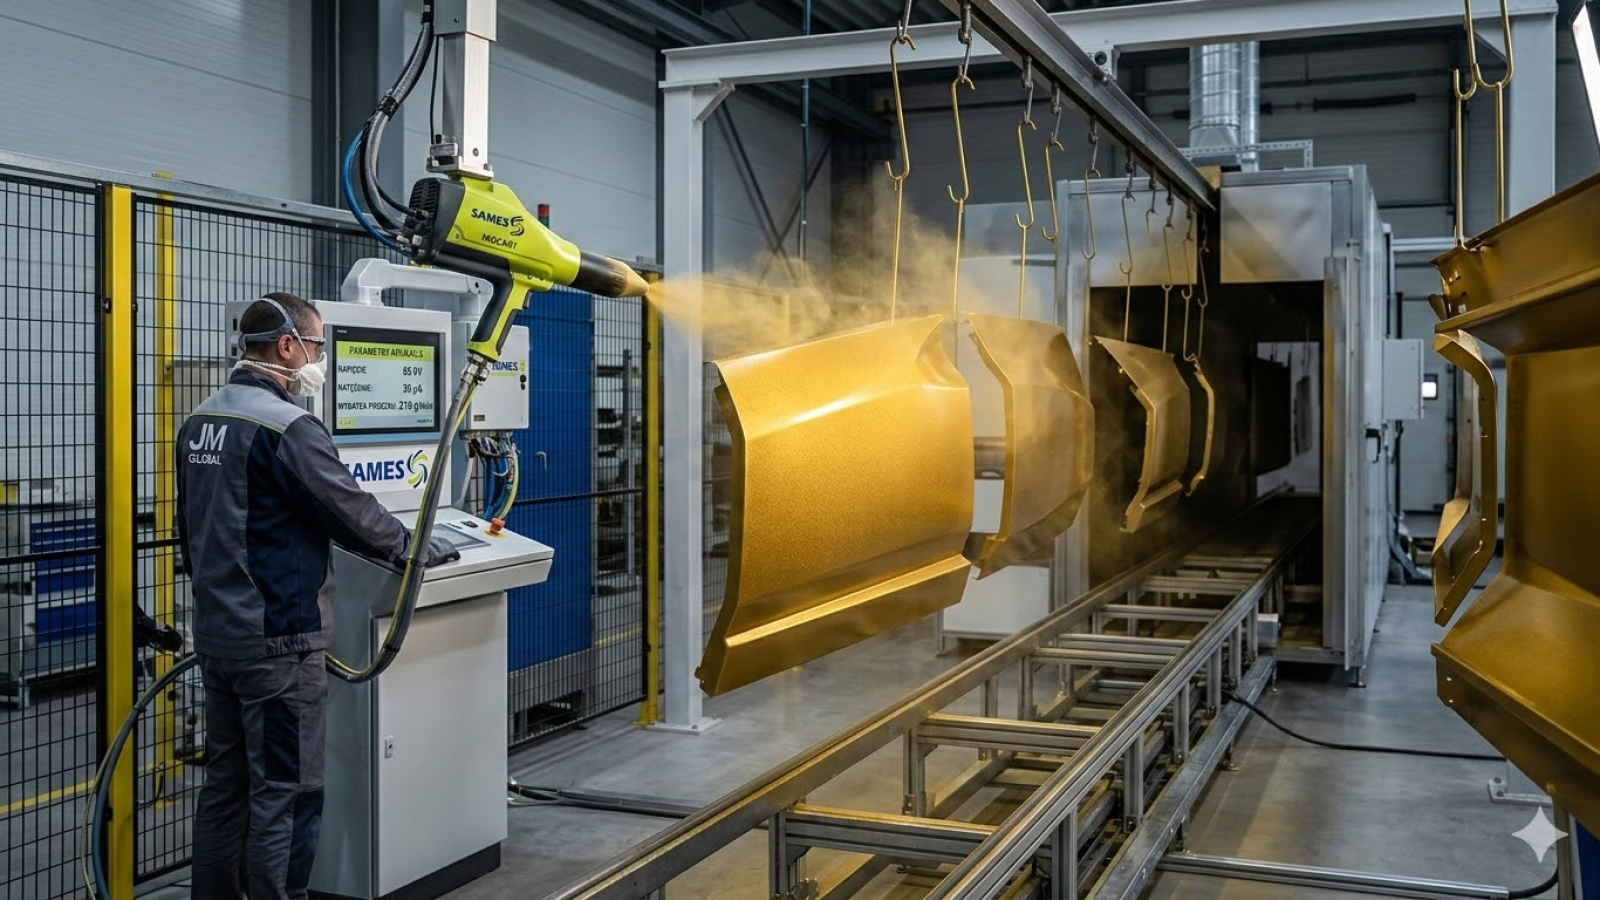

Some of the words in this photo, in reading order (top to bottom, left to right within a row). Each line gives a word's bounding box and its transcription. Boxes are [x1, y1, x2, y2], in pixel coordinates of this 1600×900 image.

[471, 208, 509, 227] SAMES
[403, 383, 412, 394] 39
[189, 423, 228, 451] JM
[188, 453, 222, 465] GLOBAL
[343, 460, 405, 482] AMES
